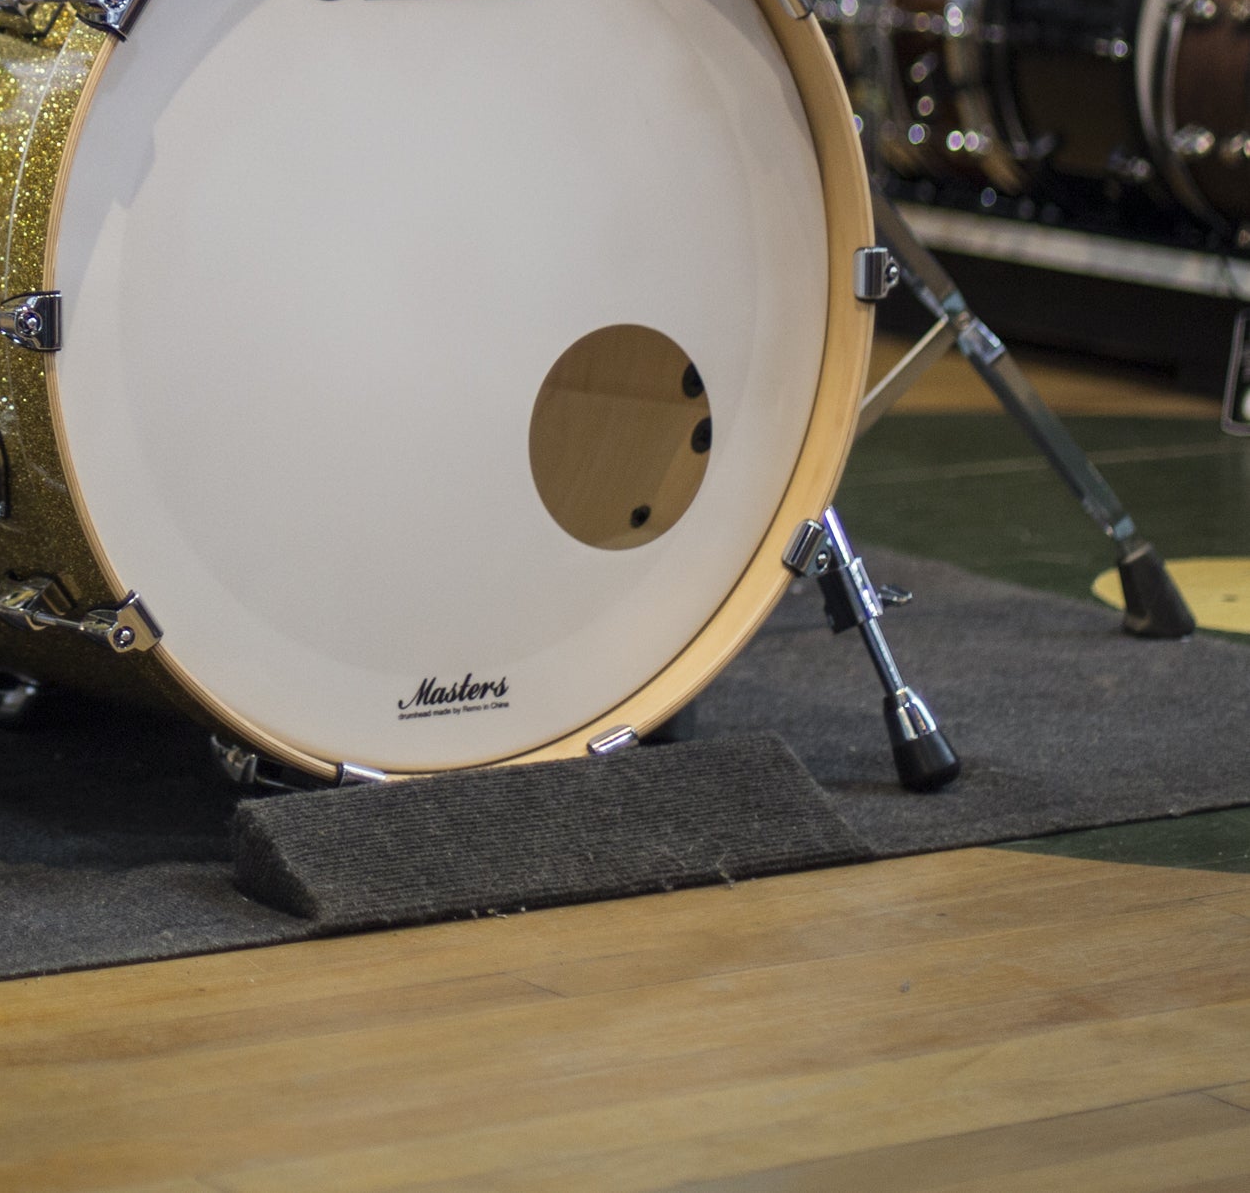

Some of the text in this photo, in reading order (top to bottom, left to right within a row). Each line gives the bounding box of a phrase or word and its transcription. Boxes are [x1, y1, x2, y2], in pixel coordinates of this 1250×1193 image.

[398, 672, 509, 710] Masters
[398, 709, 432, 720] drumhead
[433, 707, 452, 716] made
[453, 706, 461, 716] by
[462, 704, 482, 713] Remo
[490, 701, 510, 710] China
